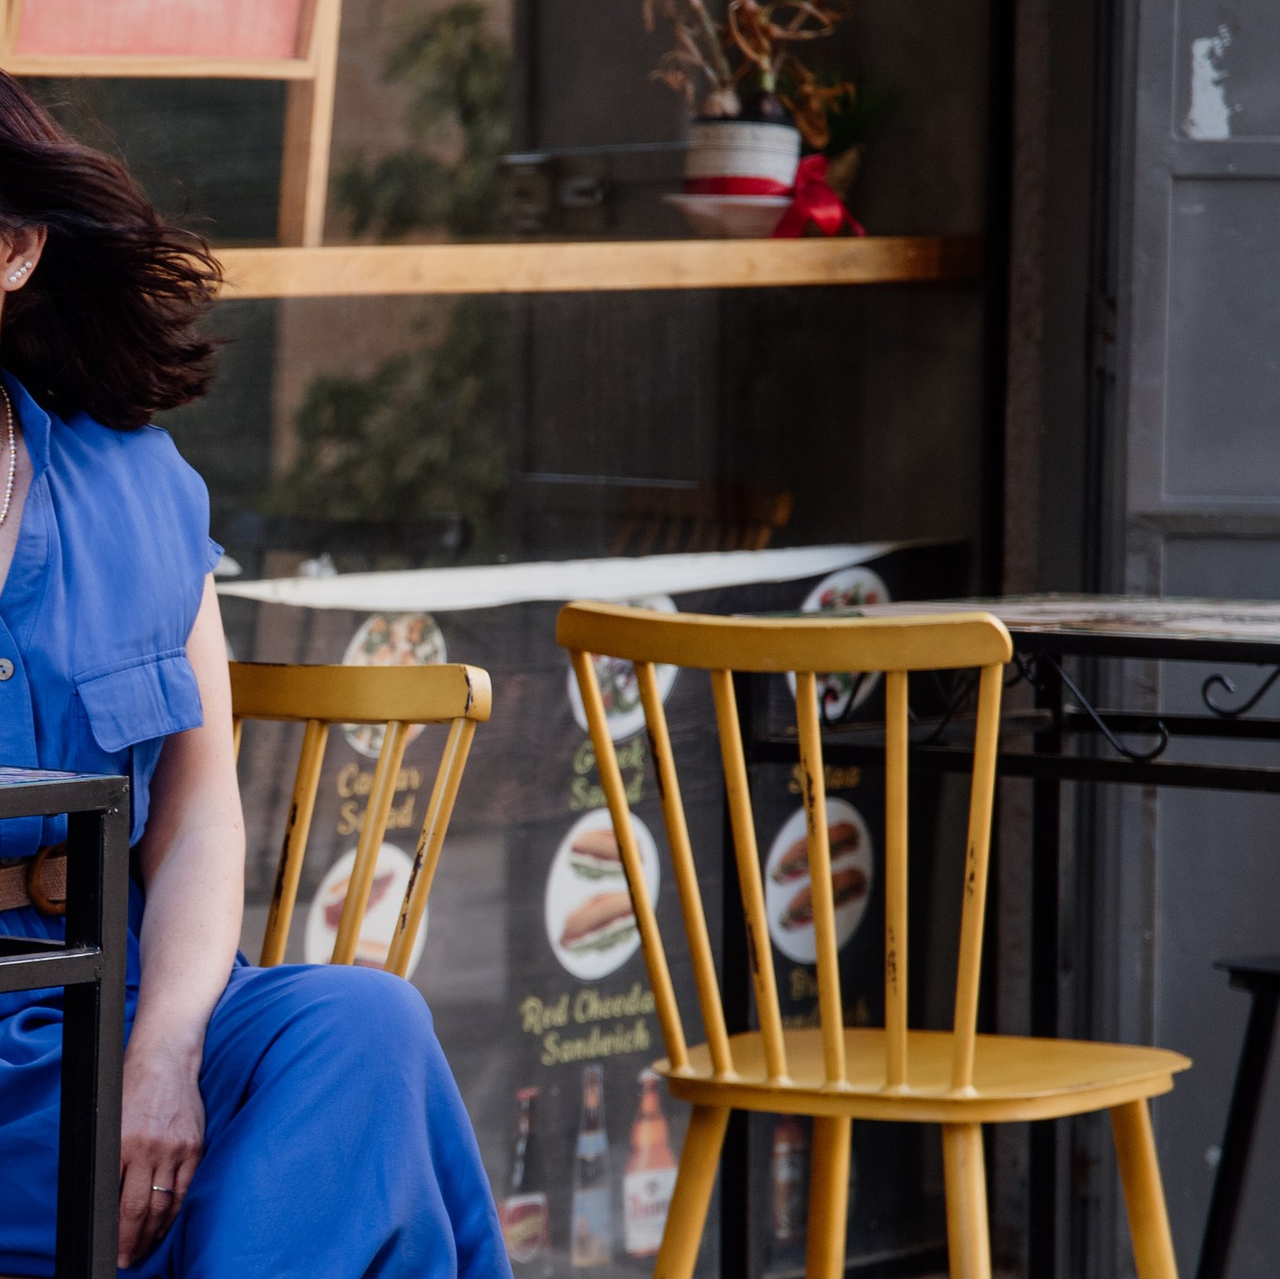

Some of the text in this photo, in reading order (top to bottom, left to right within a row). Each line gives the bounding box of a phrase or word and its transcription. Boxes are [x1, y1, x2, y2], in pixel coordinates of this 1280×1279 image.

[337, 798, 416, 836] Saad
[522, 994, 570, 1035] Red
[540, 1019, 652, 1066] Sandwich
